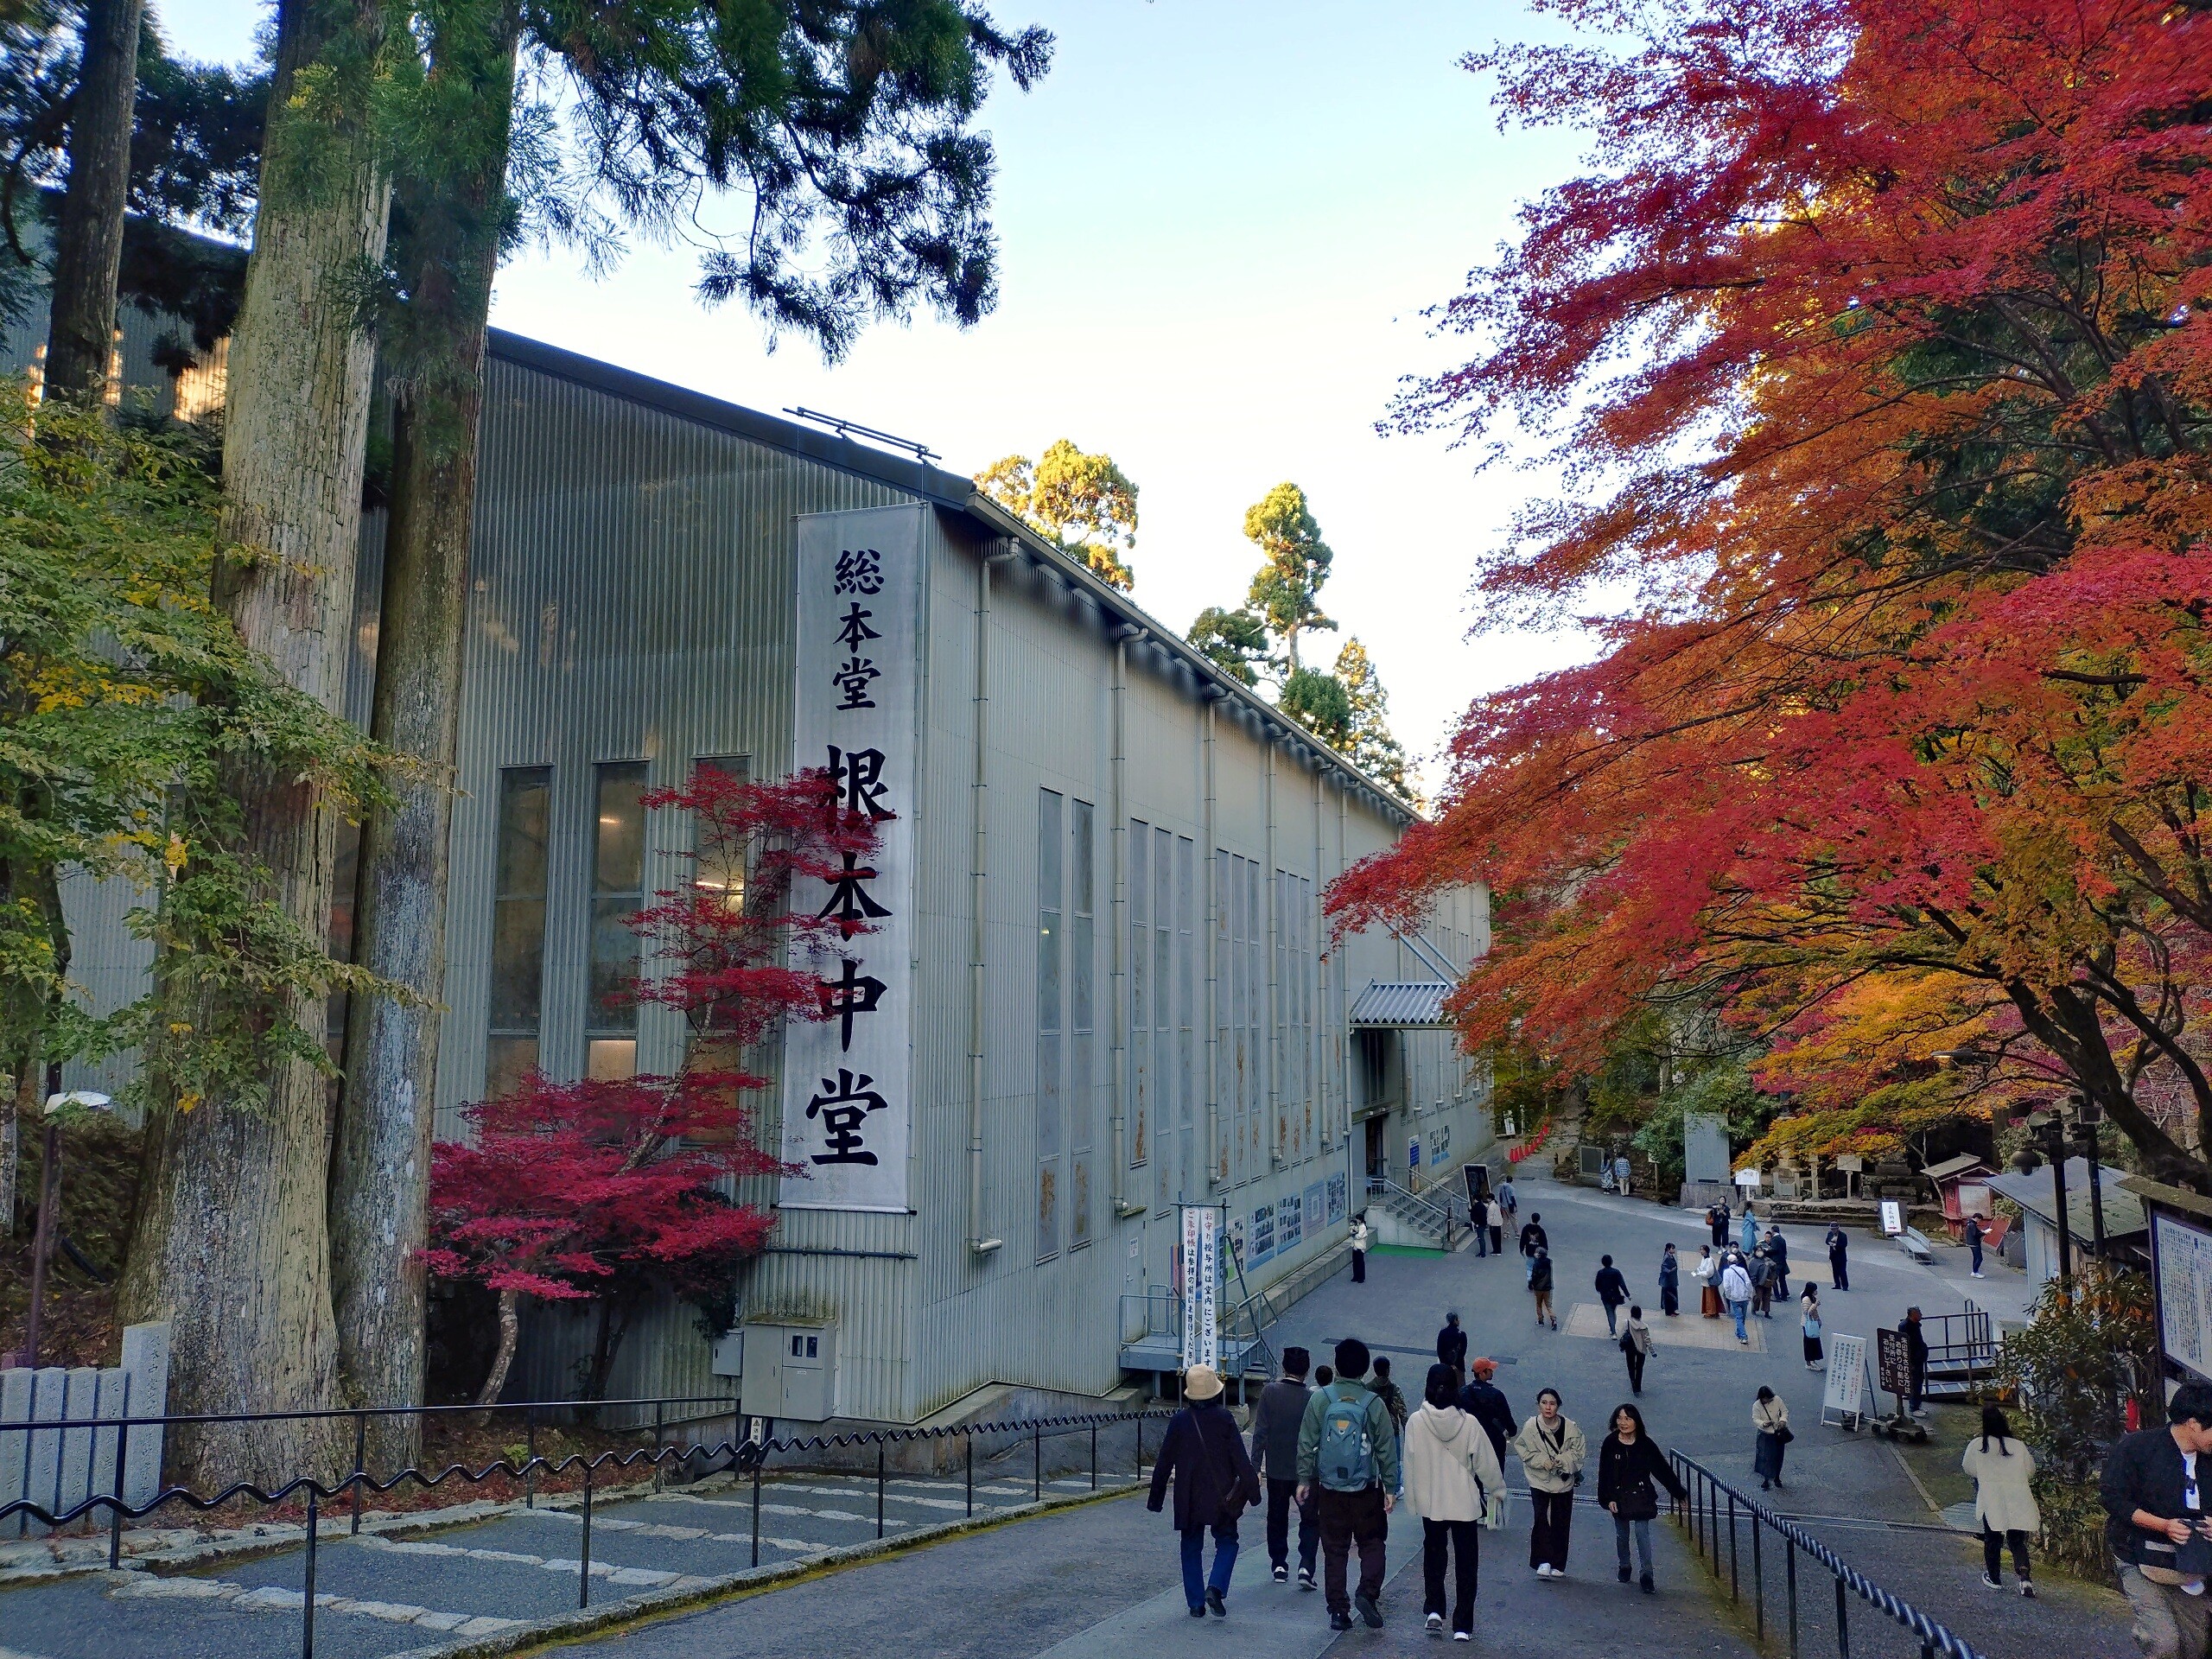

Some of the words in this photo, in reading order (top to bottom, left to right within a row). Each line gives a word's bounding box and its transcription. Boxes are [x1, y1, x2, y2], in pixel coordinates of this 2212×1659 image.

[832, 549, 885, 711] 総本堂
[805, 744, 898, 1166] 根本中堂
[1204, 1211, 1213, 1366] お守り授与所は堂内にございます
